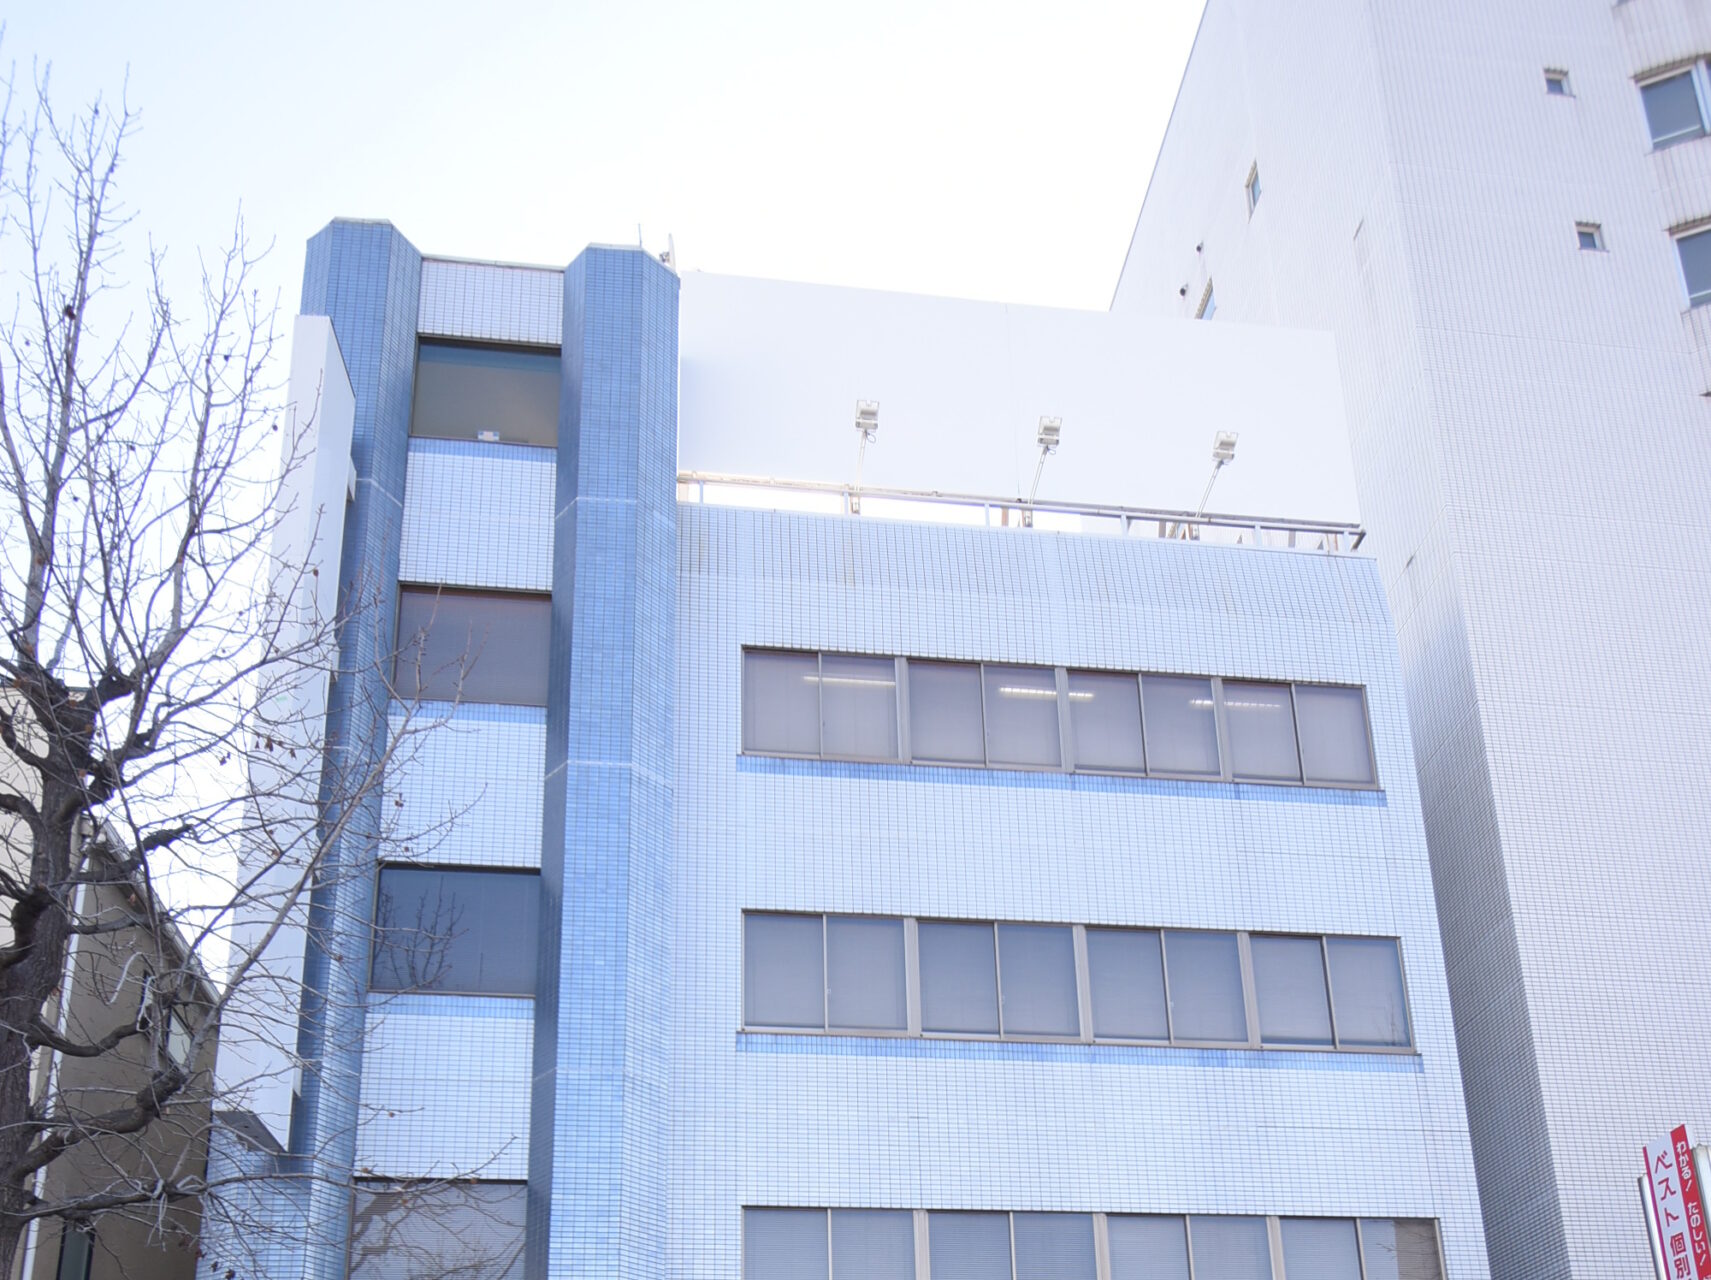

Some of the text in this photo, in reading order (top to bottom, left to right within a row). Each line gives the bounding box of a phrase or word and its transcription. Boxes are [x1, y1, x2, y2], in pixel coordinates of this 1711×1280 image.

[1676, 1140, 1692, 1192] わかる！
[1687, 1201, 1707, 1267] たのしい！
